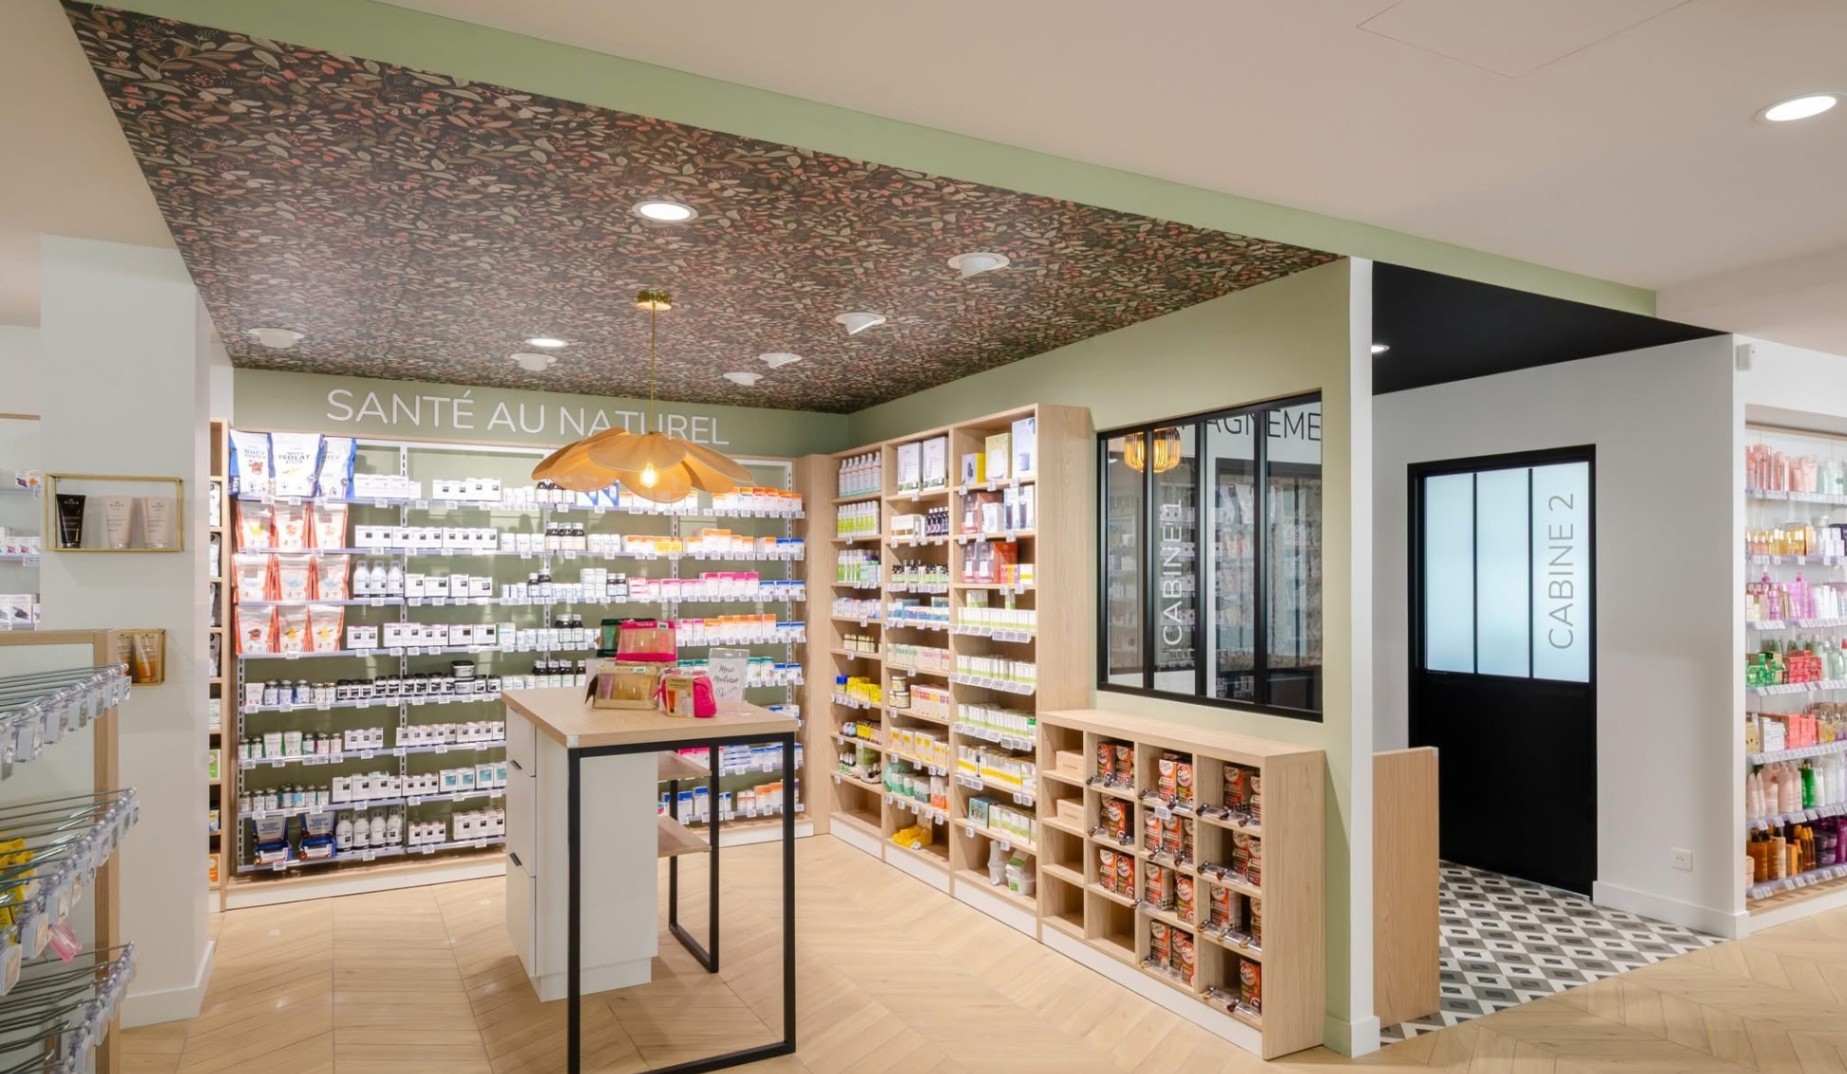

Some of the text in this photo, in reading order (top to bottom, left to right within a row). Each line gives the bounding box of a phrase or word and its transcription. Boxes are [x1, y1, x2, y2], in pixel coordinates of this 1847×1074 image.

[326, 388, 730, 445] SANTÉ AU NATUREL
[1162, 526, 1183, 646] CABINE
[1548, 493, 1574, 650] CABINE 2
